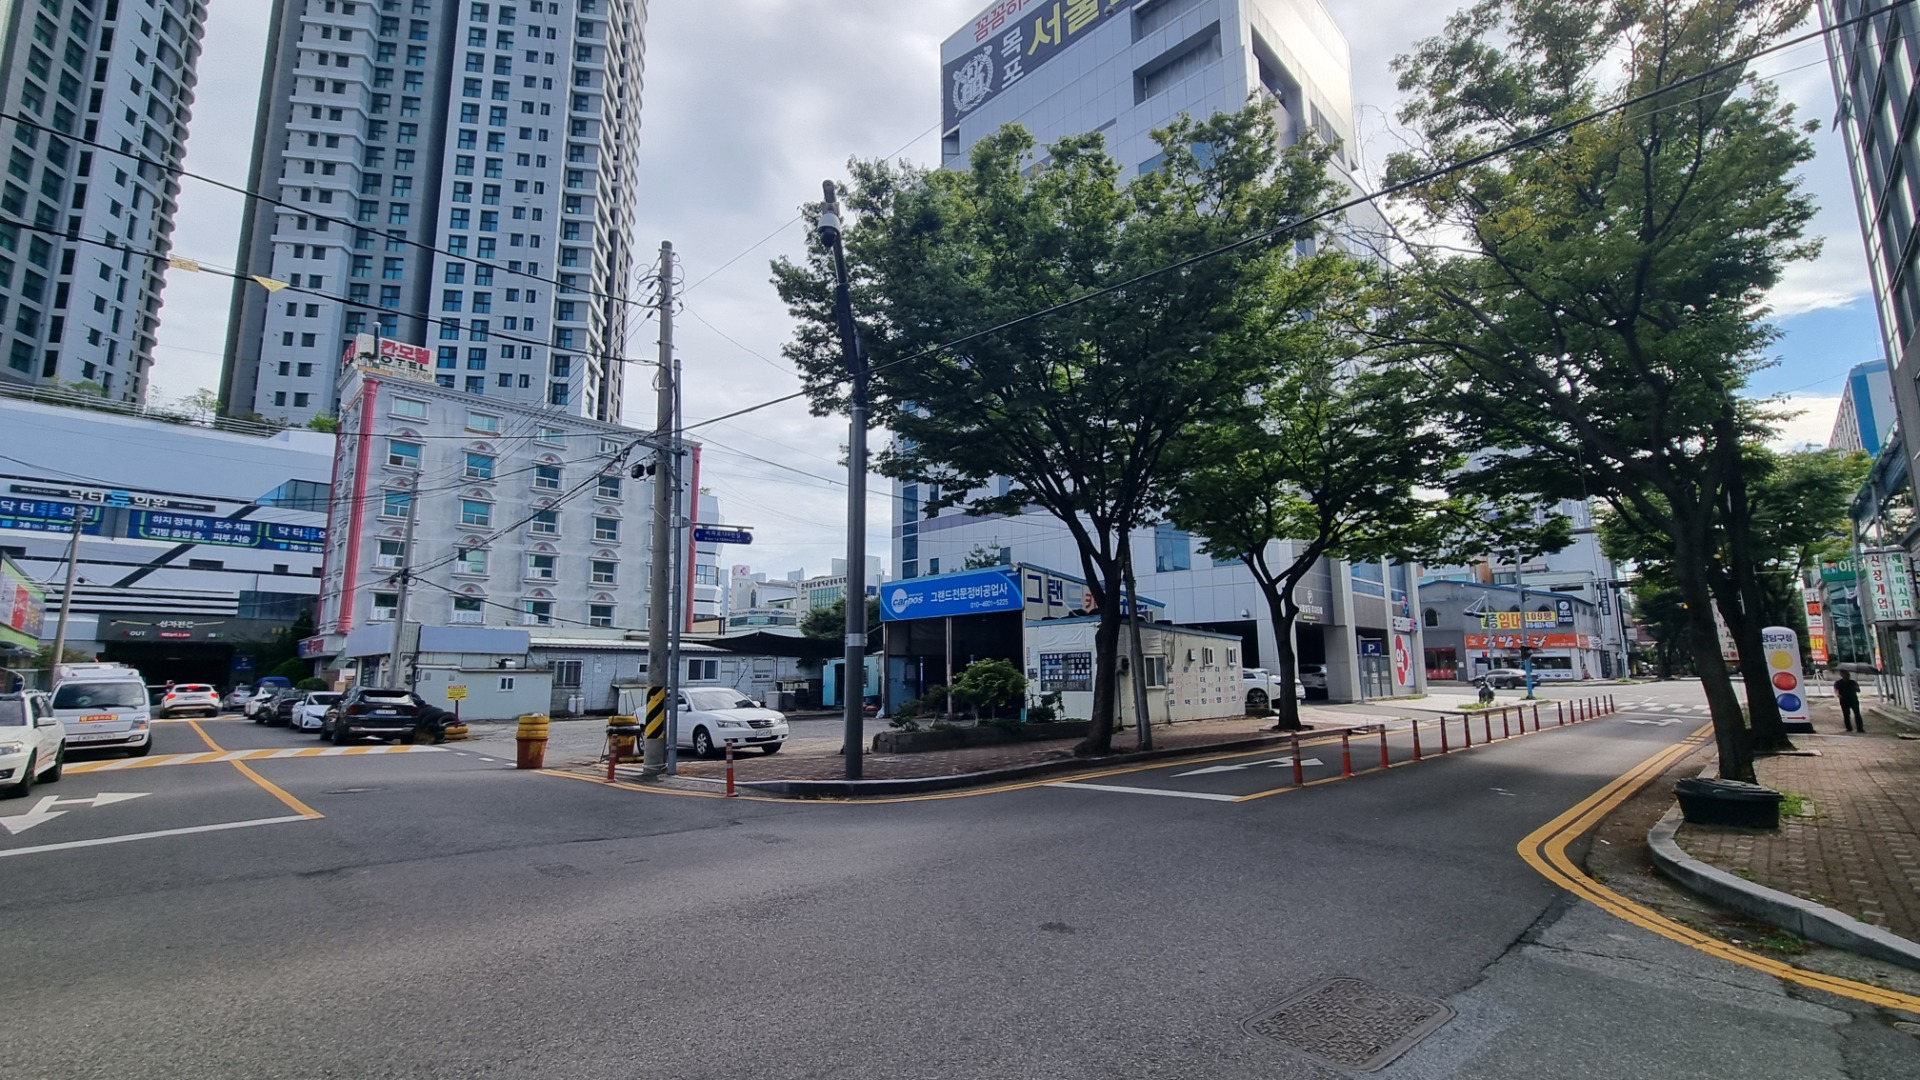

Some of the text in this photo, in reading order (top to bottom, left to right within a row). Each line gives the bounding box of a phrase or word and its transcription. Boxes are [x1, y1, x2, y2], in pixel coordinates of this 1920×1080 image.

[1027, 0, 1121, 55] 서울
[1001, 26, 1024, 89] 목포
[381, 340, 431, 365] 칸모텔
[381, 356, 428, 372] OTEL
[930, 583, 1009, 602] 그랜드전문정비공업사
[1026, 574, 1082, 609] 그랜드
[892, 596, 924, 607] carpos
[1498, 611, 1521, 628] 임대
[1367, 643, 1376, 653] P
